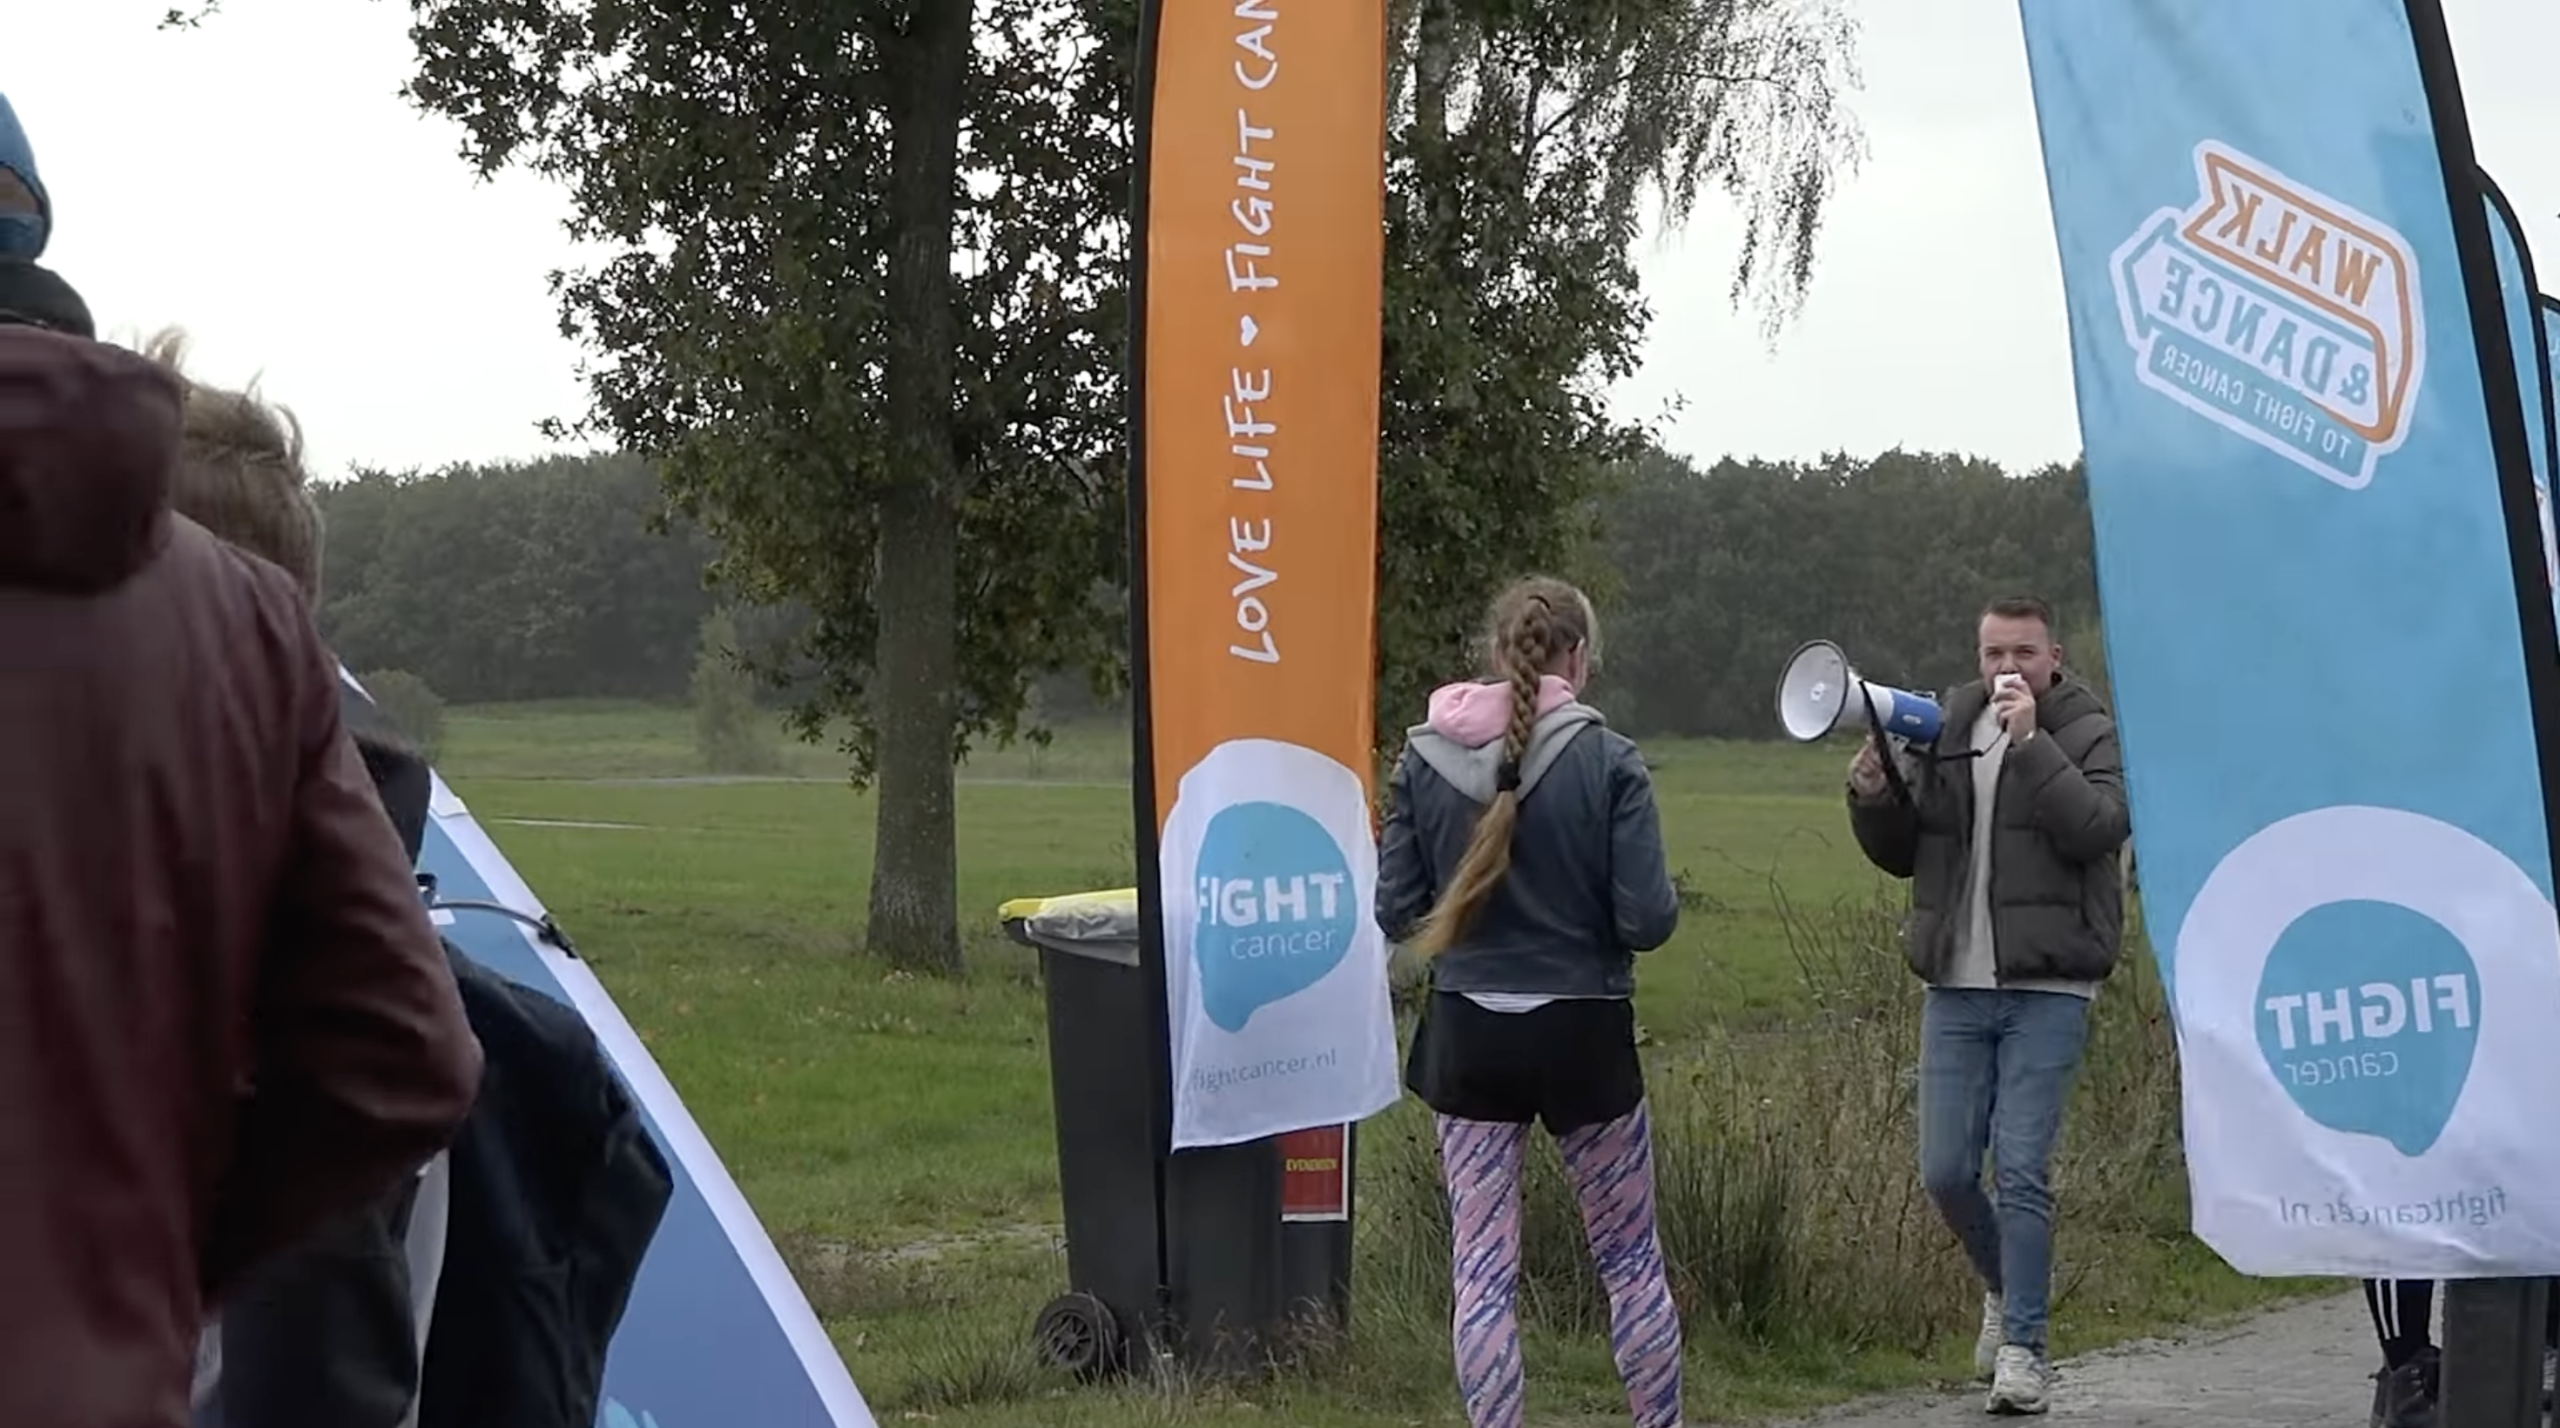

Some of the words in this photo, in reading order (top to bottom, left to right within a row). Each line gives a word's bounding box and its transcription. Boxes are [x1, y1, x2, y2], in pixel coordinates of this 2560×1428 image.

[1225, 108, 1279, 292] FIGHT
[1224, 366, 1277, 490] LIFE
[1228, 517, 1280, 664] LOVE
[1230, 927, 1337, 960] cancer
